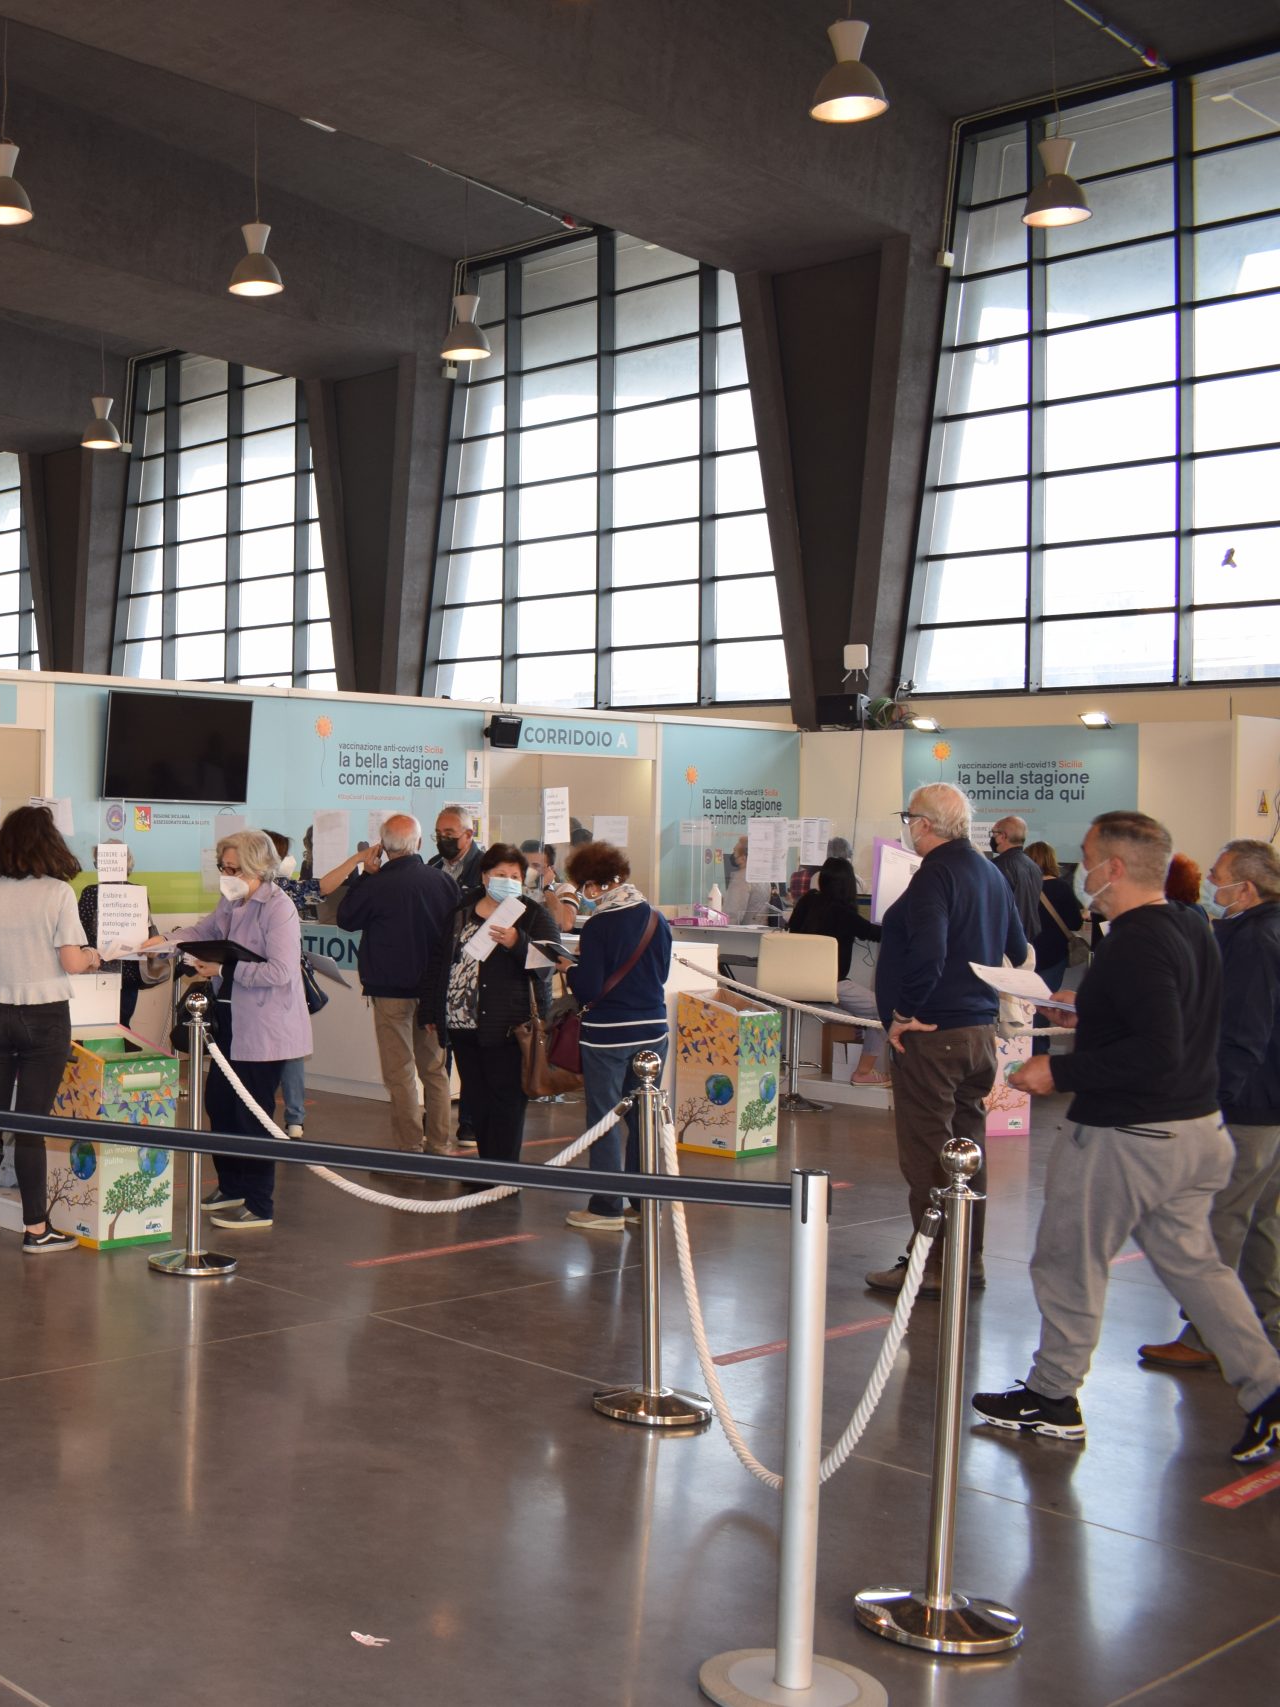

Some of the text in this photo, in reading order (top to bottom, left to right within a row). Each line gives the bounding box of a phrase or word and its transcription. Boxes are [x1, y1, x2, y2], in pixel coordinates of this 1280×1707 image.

[524, 726, 628, 748] CORRIDOIO A
[339, 742, 444, 754] vaccinazione anti-covid19 Sicilia
[339, 751, 449, 773] la bella stagione
[957, 760, 1083, 769] vaccinazione anti-covid19 Sicilia
[338, 771, 445, 788] comincia da qui
[958, 771, 1090, 787] la bella stagione
[1034, 786, 1054, 800] da
[1060, 786, 1085, 803] qui
[702, 796, 782, 813] la bella stagione
[303, 936, 359, 963] TION
